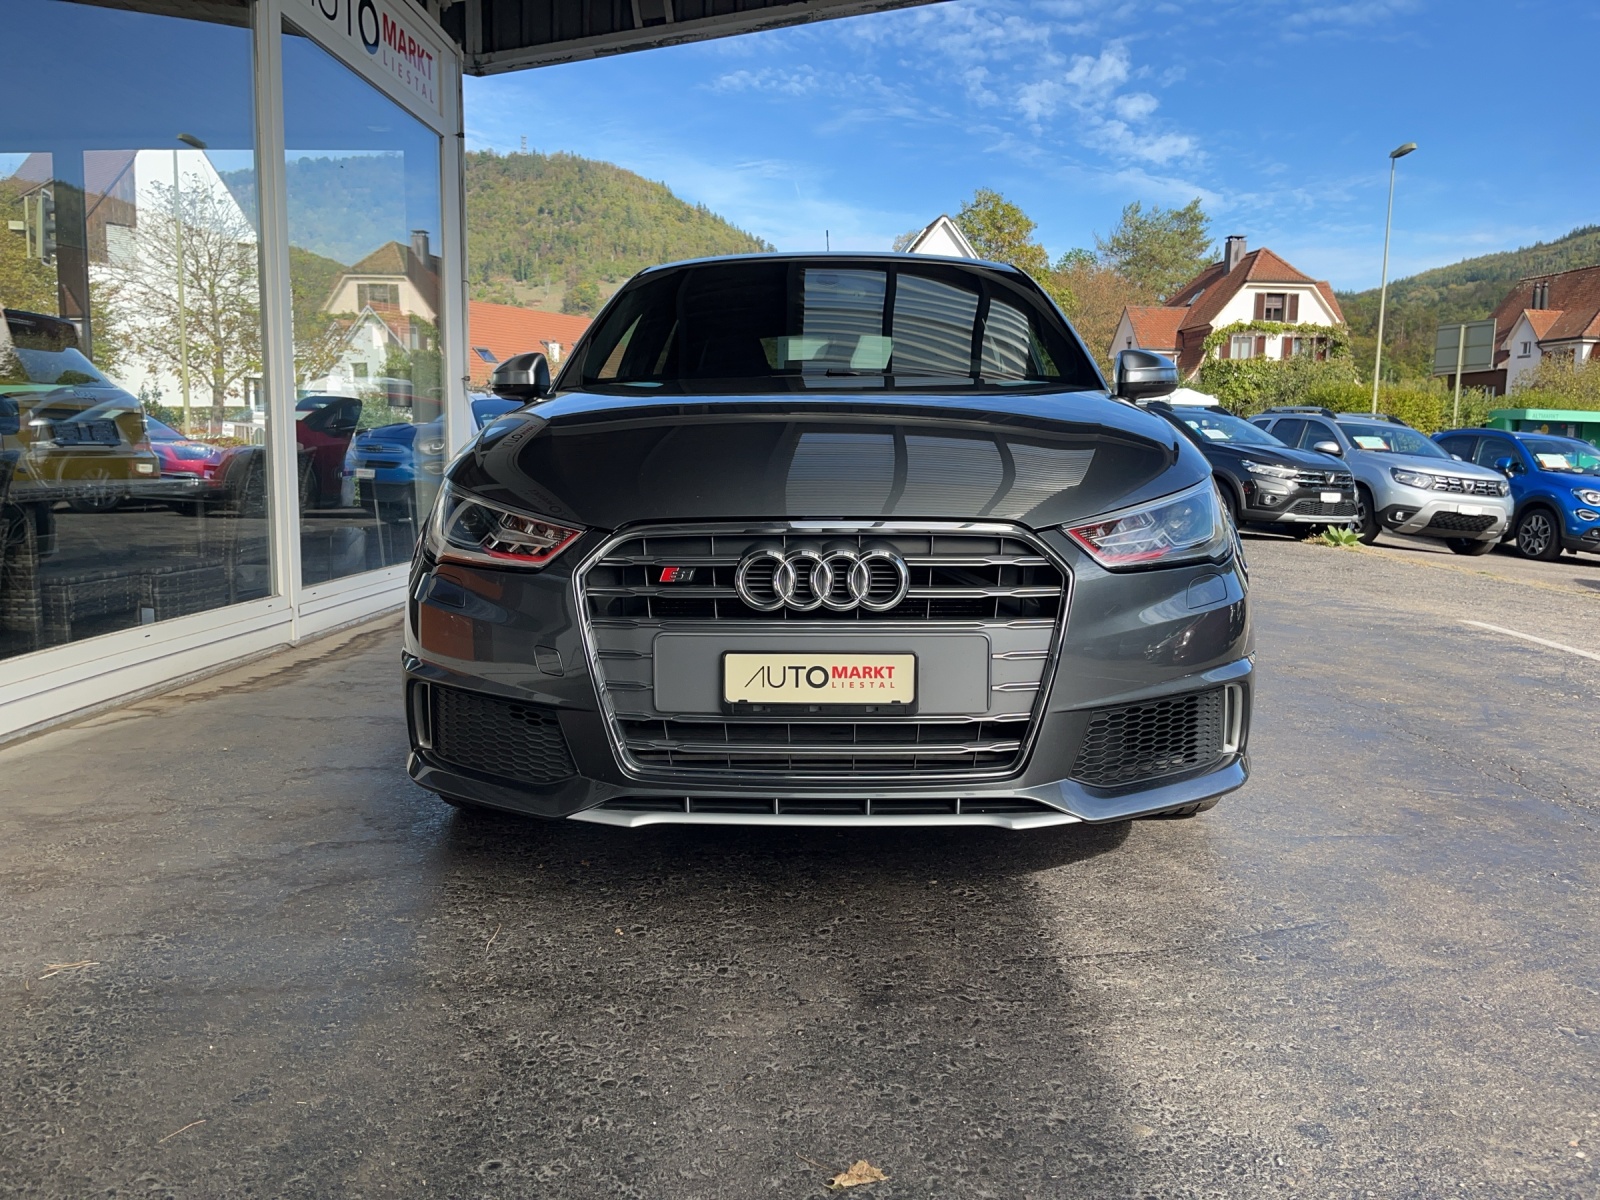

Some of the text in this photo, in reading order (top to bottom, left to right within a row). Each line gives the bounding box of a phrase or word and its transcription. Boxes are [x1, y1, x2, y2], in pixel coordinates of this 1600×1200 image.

[310, 0, 433, 81] TO MARKT
[382, 49, 434, 104] LIESTAL
[744, 665, 896, 689] AUTO MARKT
[831, 681, 896, 689] LIESTAL
